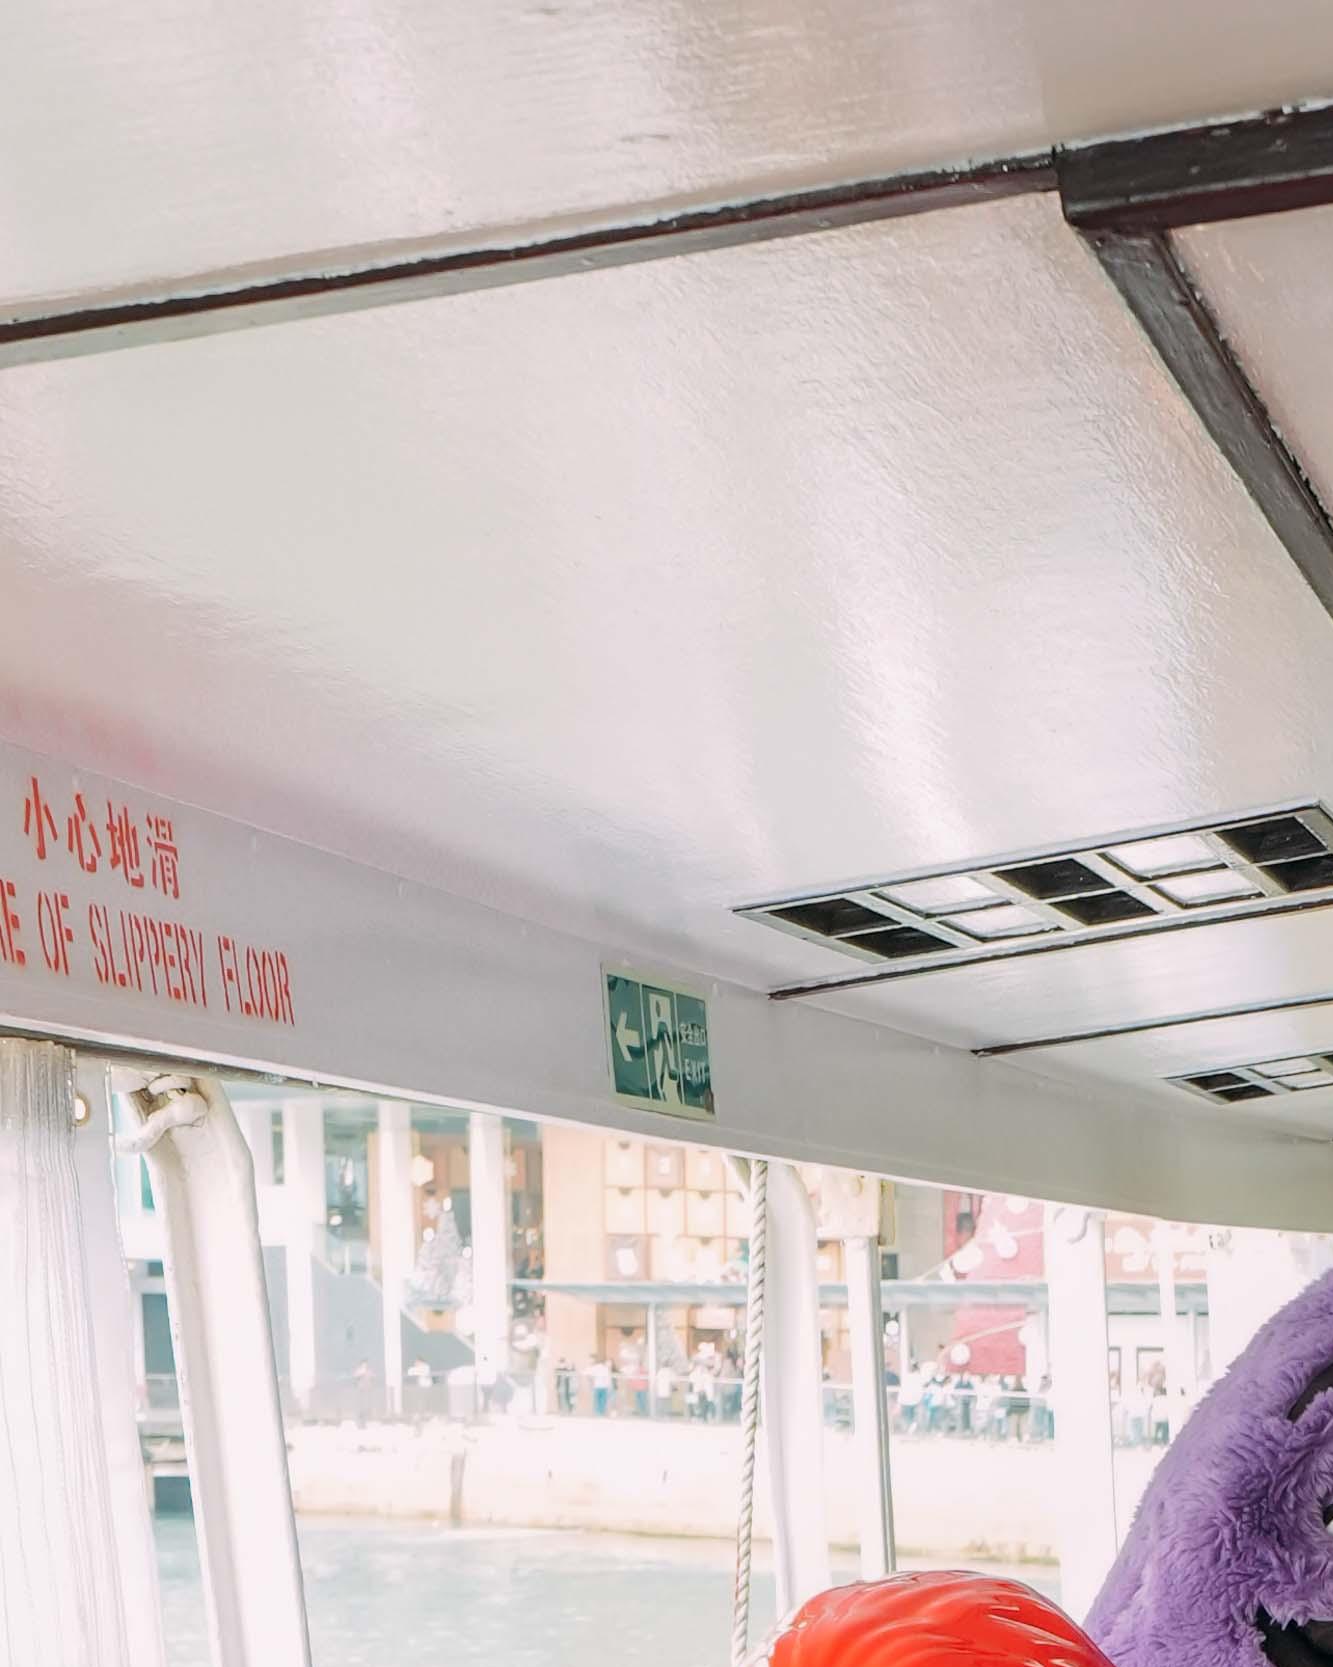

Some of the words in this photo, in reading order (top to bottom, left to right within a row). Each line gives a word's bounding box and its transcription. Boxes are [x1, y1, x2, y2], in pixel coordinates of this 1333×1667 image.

[24, 776, 180, 900] 小心地滑
[37, 889, 74, 976] OF
[88, 902, 208, 1009] SLIPPERY
[217, 934, 296, 1027] FLOOR
